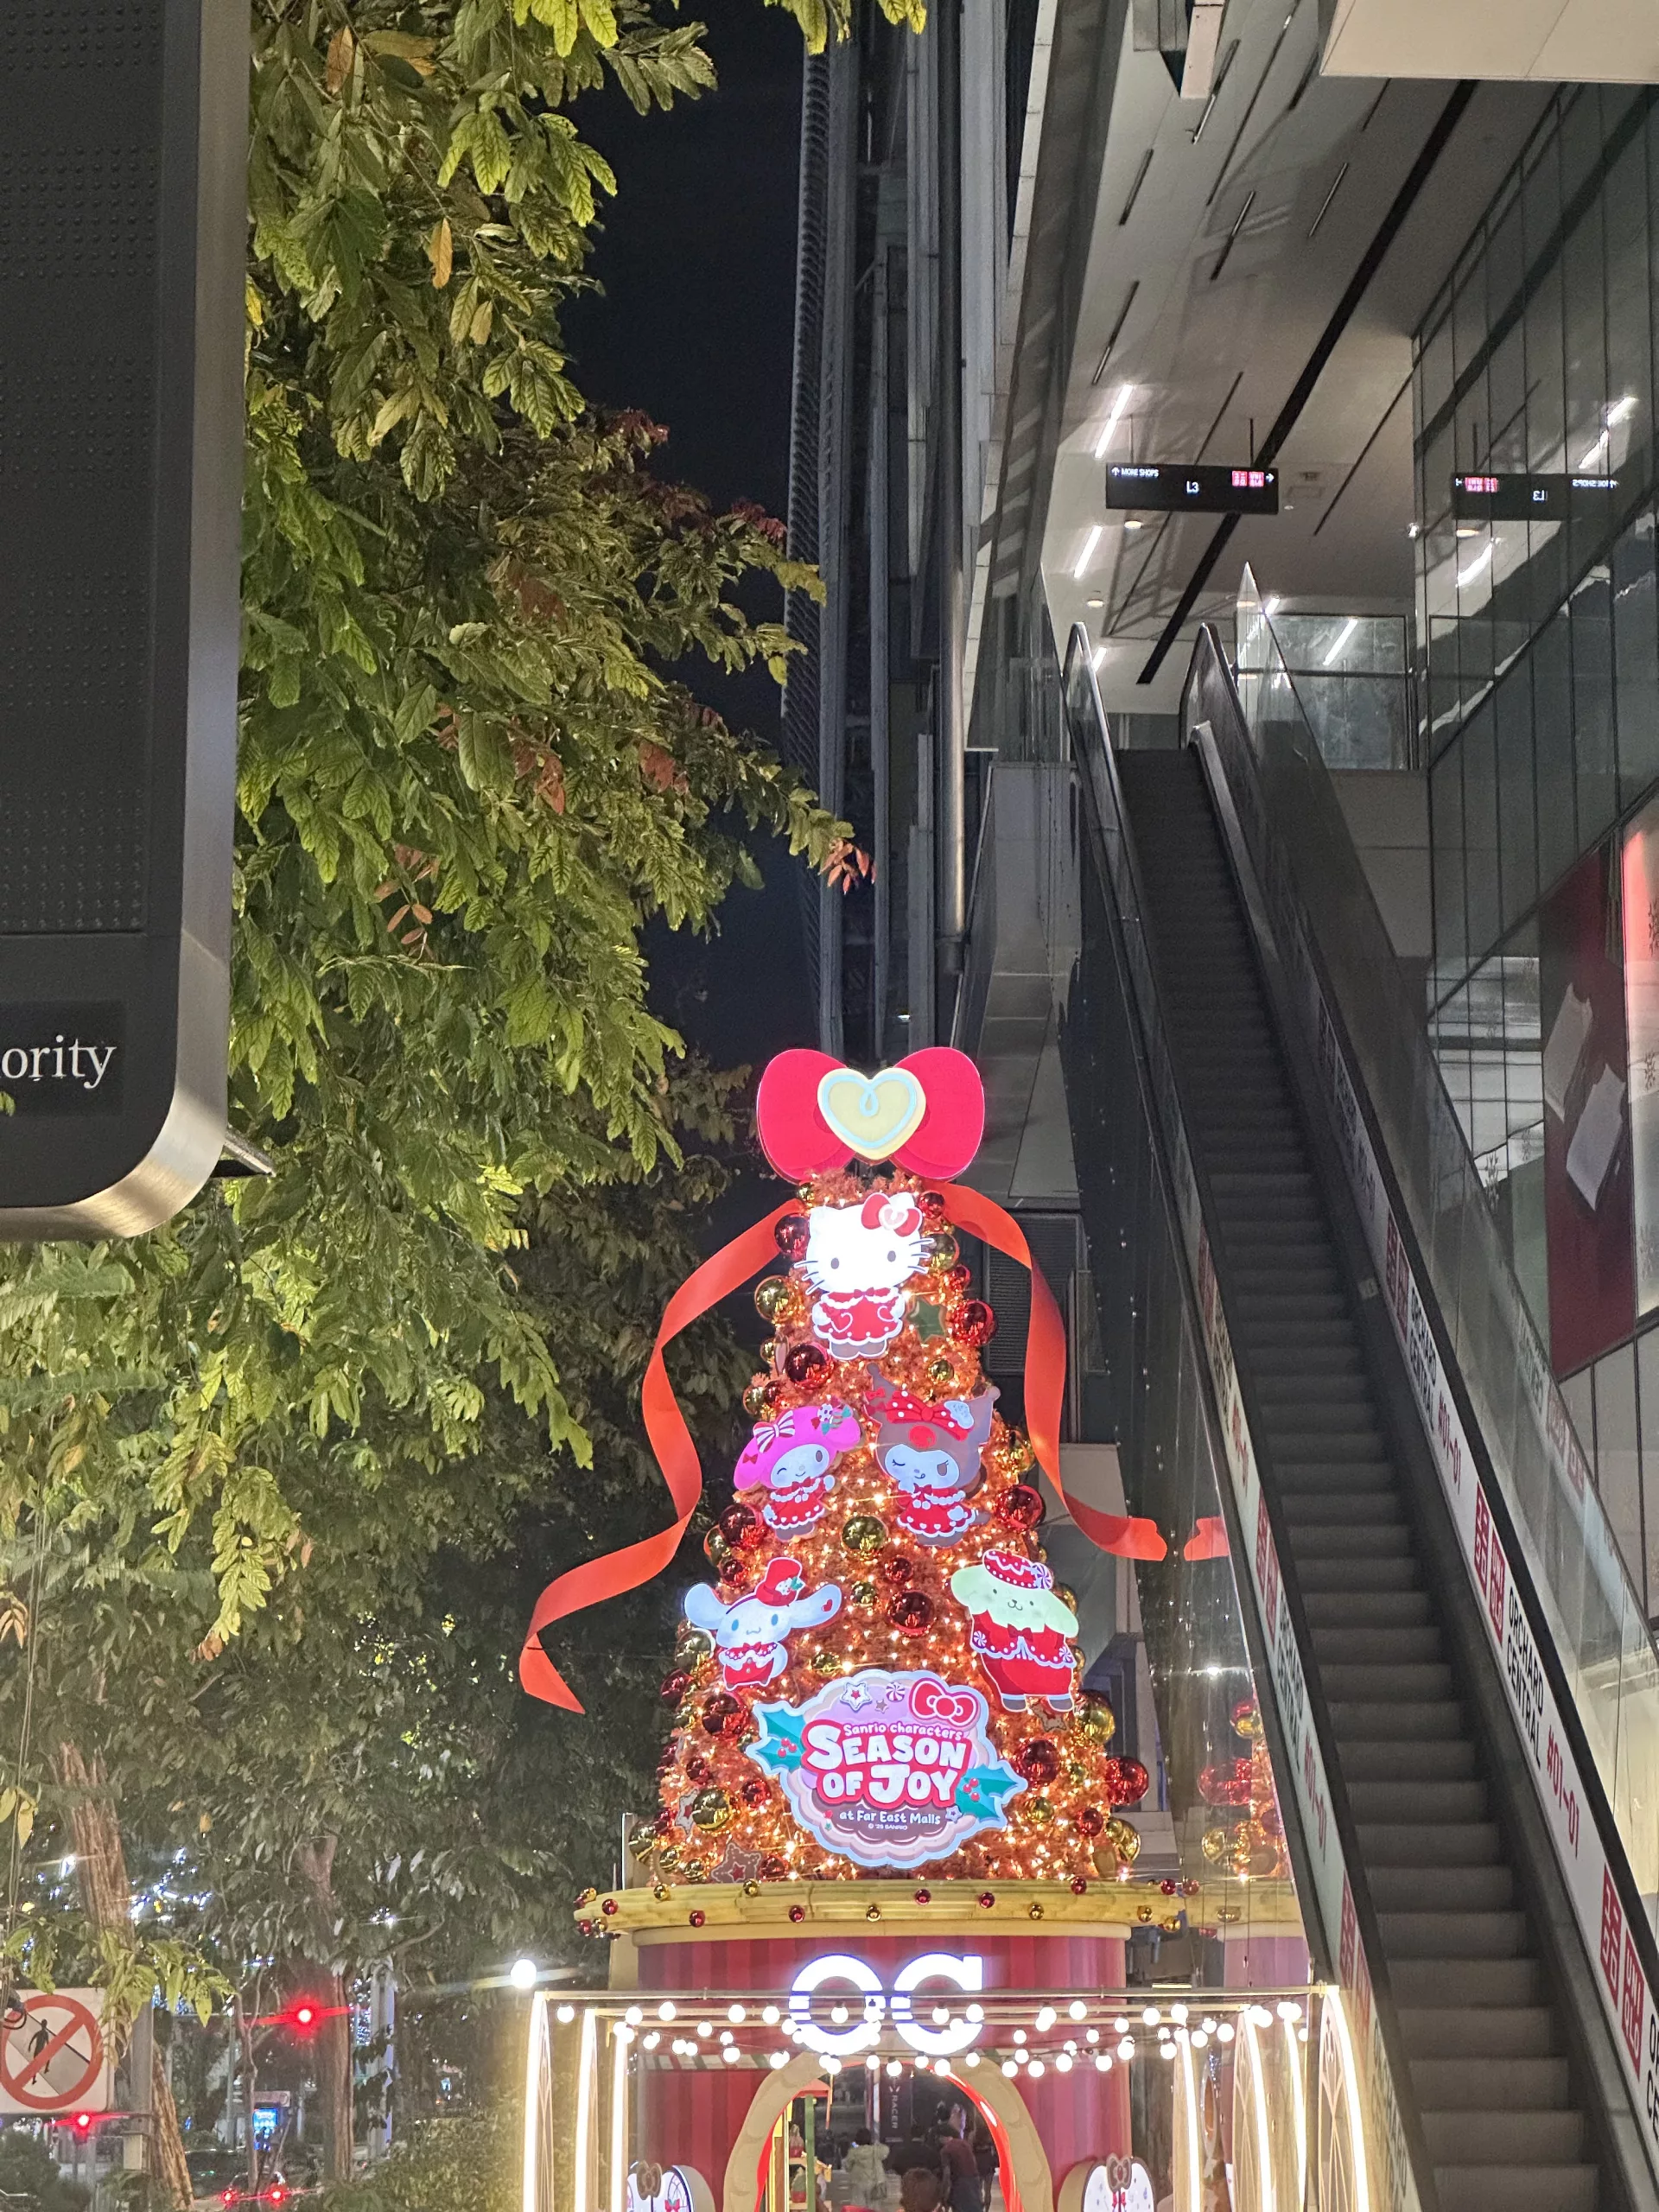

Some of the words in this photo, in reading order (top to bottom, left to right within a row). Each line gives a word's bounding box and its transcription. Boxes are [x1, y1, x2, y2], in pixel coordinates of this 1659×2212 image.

[1122, 467, 1138, 476] MORE
[1139, 468, 1159, 478] SHOPS
[1186, 481, 1199, 493] L3
[1, 1034, 118, 1089] ority
[1509, 1586, 1544, 1717] ORCHARD
[1507, 1634, 1541, 1770] CENTRAL
[806, 1724, 966, 1770] SEASON
[843, 1722, 887, 1737] Sanrio
[889, 1721, 963, 1741] characters
[822, 1770, 865, 1799] OF
[868, 1764, 958, 1803] JOY
[1547, 1725, 1580, 1859] #01-01
[839, 1810, 855, 1821] at
[857, 1810, 877, 1822] Far
[880, 1811, 907, 1823] East
[910, 1813, 941, 1825] Malls
[788, 1952, 983, 2056] OC
[1626, 1948, 1641, 2016] UNI
[1624, 1993, 1640, 2059] QLO
